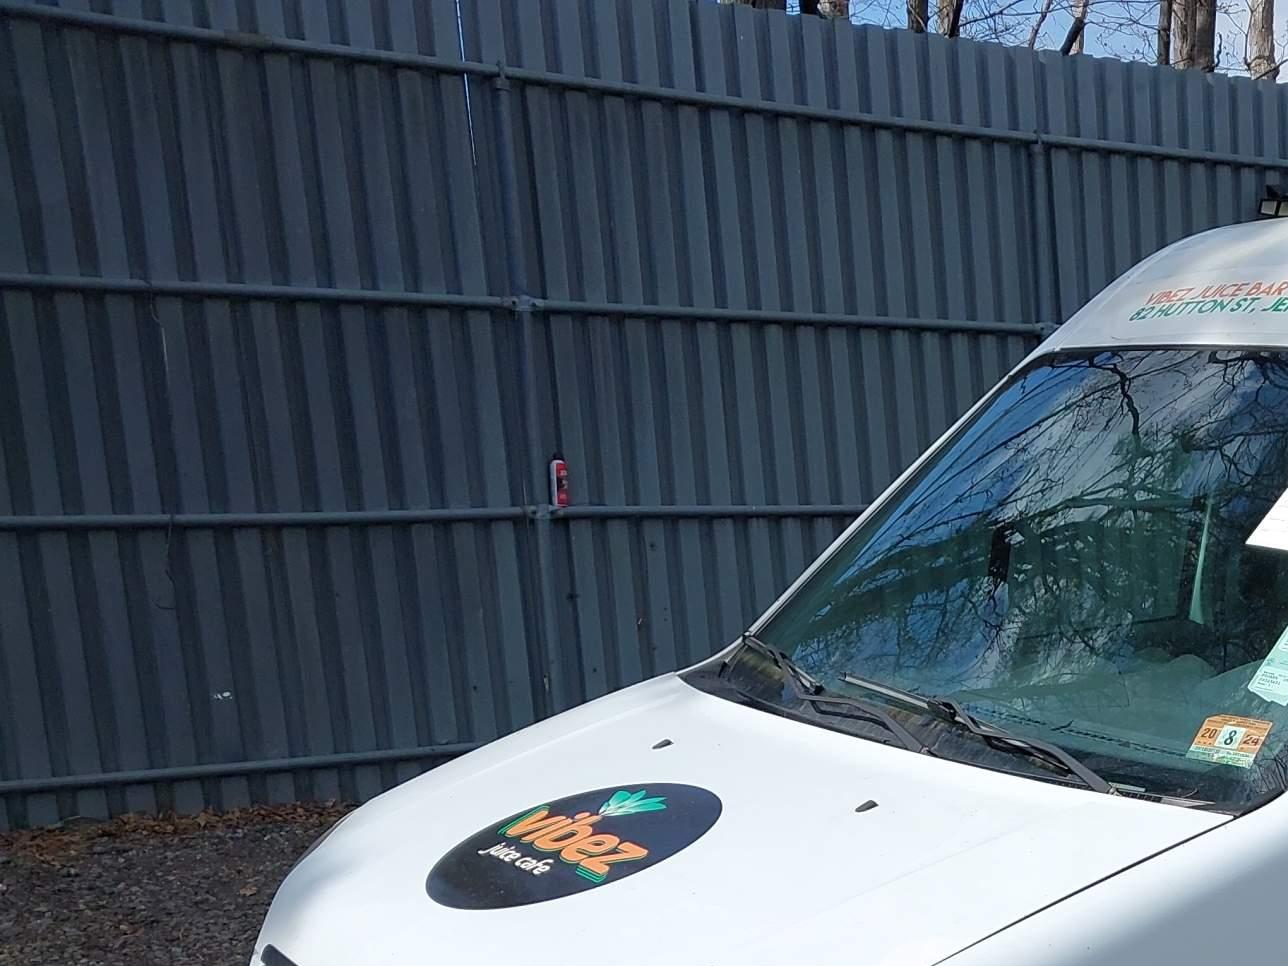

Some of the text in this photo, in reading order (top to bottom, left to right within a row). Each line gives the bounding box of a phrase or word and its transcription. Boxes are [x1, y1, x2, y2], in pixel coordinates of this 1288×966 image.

[1145, 288, 1195, 305] VIBEZ
[1191, 283, 1249, 299] JUICE
[1128, 306, 1155, 322] 82
[1152, 298, 1234, 319] HUTTON
[1229, 297, 1261, 314] ST,
[1201, 728, 1217, 739] 20
[1224, 730, 1237, 745] 8
[500, 807, 649, 879] vibez
[478, 842, 554, 875] juice cafe
